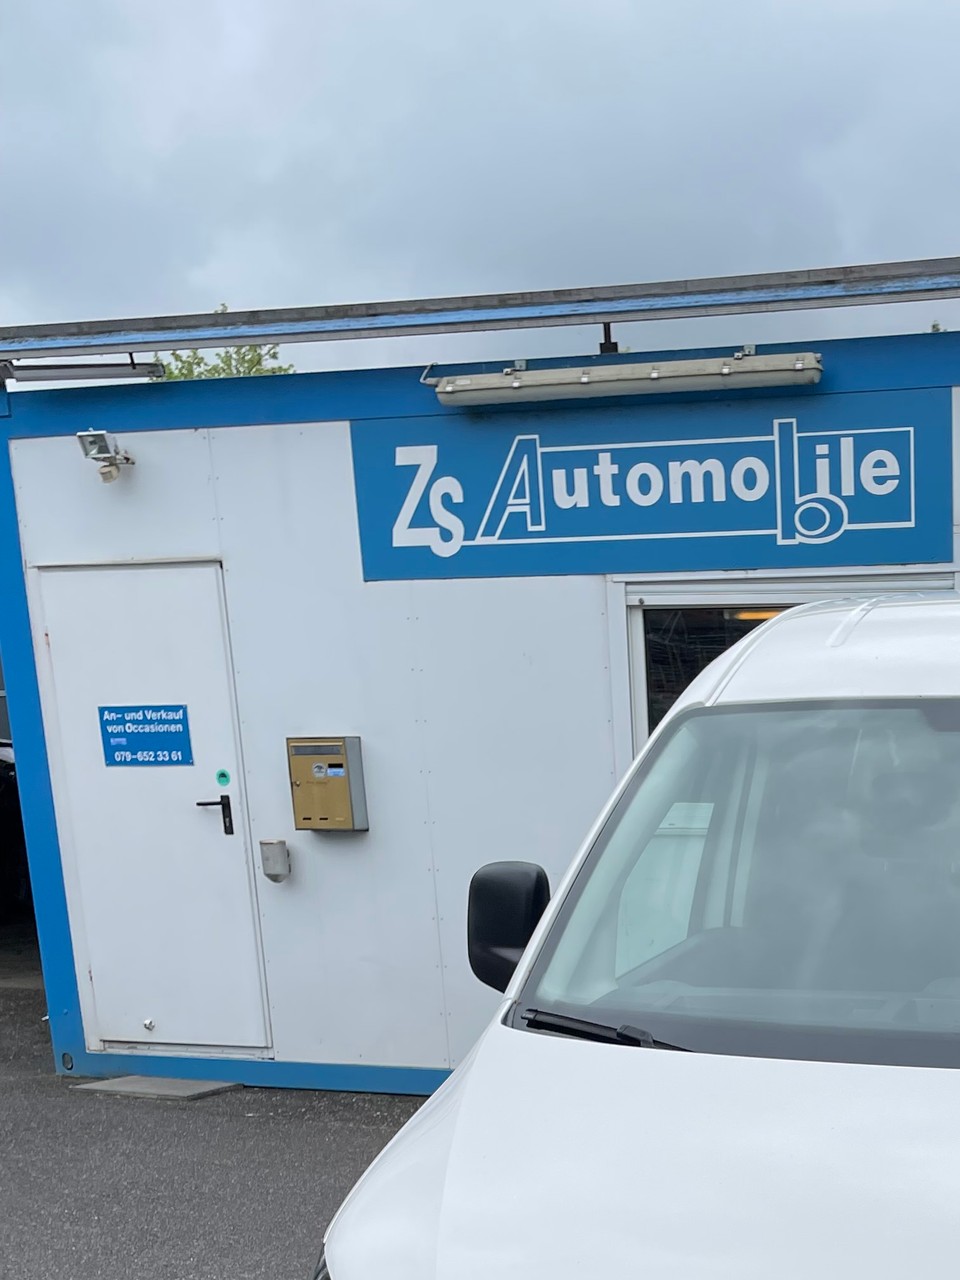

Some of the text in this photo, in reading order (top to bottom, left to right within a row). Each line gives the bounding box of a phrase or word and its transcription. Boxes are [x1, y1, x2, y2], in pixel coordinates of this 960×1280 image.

[476, 418, 900, 545] Automobile
[103, 709, 184, 721] An- und Verkauf
[106, 722, 183, 733] von Occasionen
[156, 751, 169, 761] 33
[171, 751, 182, 761] 61
